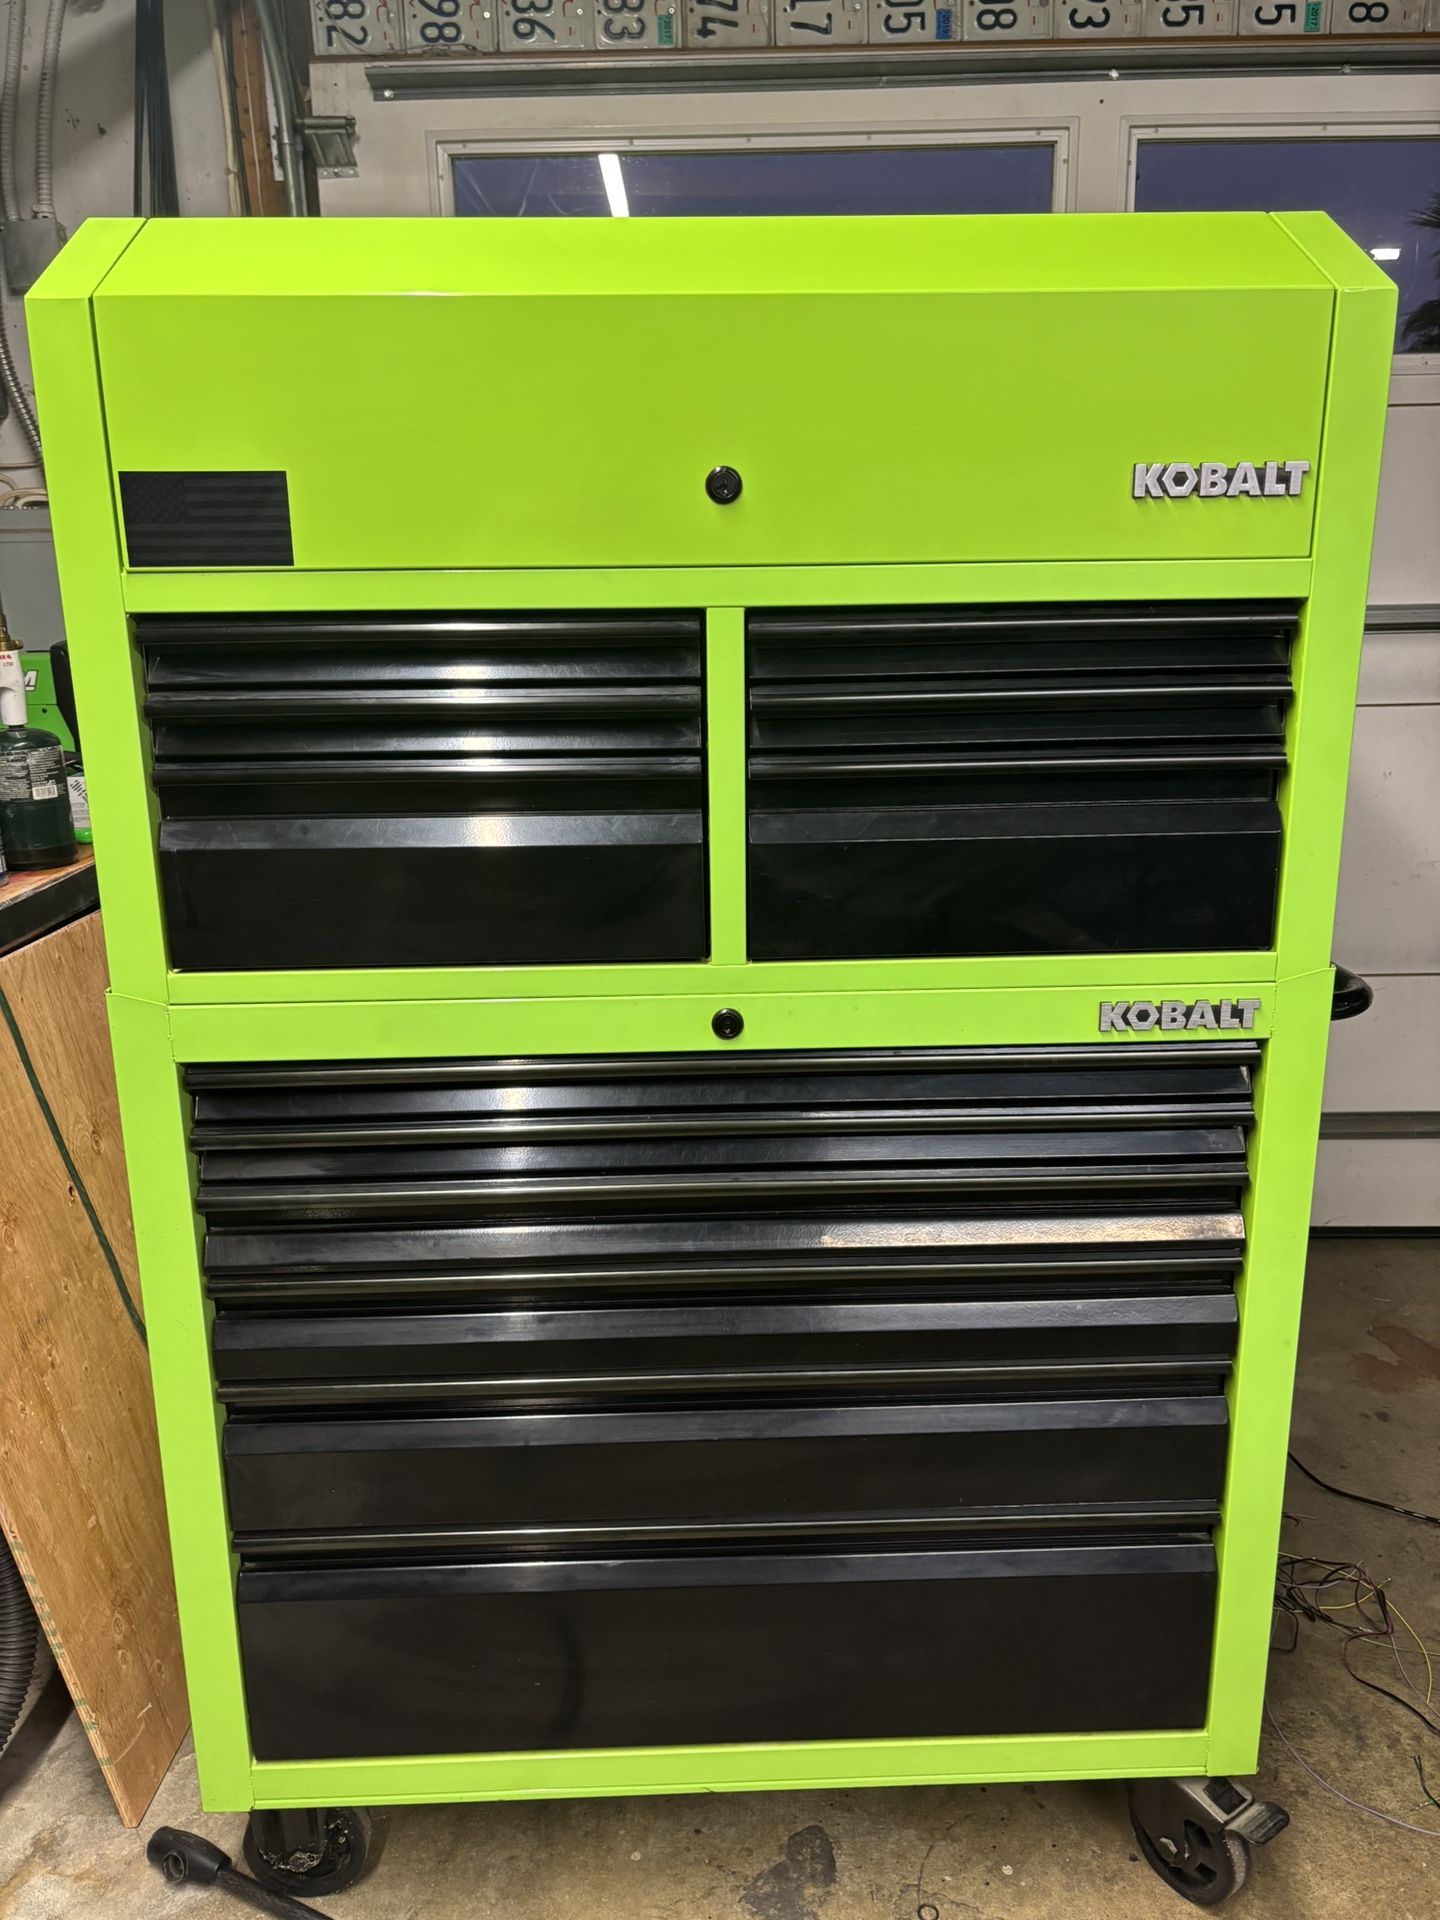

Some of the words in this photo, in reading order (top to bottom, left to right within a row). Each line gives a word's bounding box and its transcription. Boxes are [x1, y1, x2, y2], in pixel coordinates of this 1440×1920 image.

[325, 0, 369, 47] 82
[418, 0, 462, 43] 98
[976, 0, 1018, 30] 8
[1069, 0, 1111, 28] 3
[1162, 0, 1204, 27] 5
[1133, 461, 1309, 498] KOBALT
[1099, 998, 1260, 1032] KOBALT
